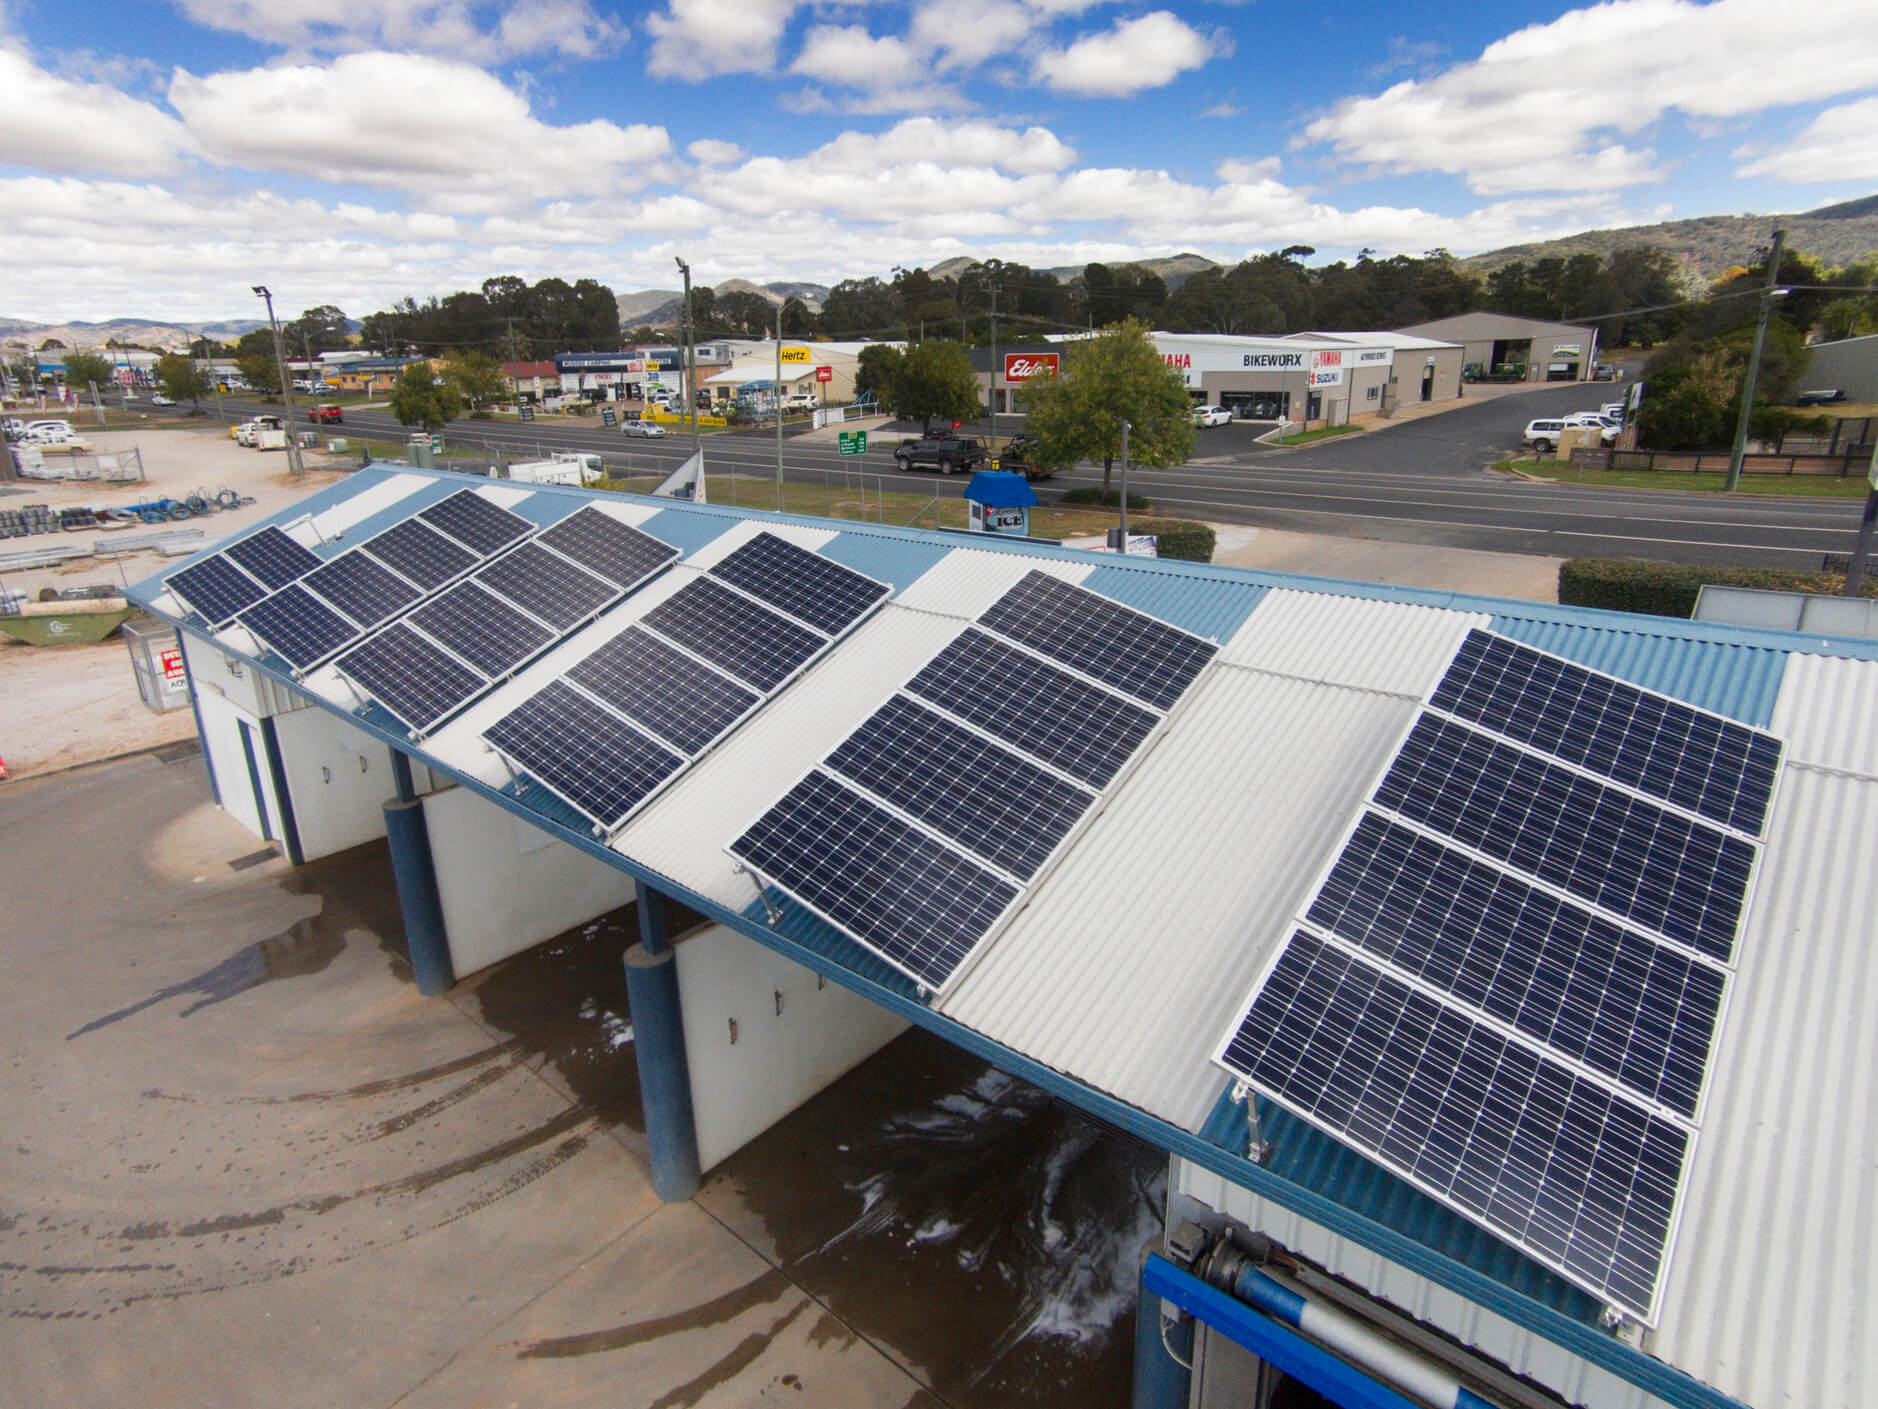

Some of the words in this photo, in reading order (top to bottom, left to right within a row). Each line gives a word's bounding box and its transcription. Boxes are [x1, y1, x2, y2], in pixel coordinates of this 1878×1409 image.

[782, 351, 806, 361] Hertz
[1157, 353, 1191, 369] MAHA
[1243, 353, 1302, 367] BIKEWORX
[1320, 351, 1342, 366] YAMAHA
[1316, 372, 1339, 384] SUZUKI
[997, 515, 1022, 527] ICE
